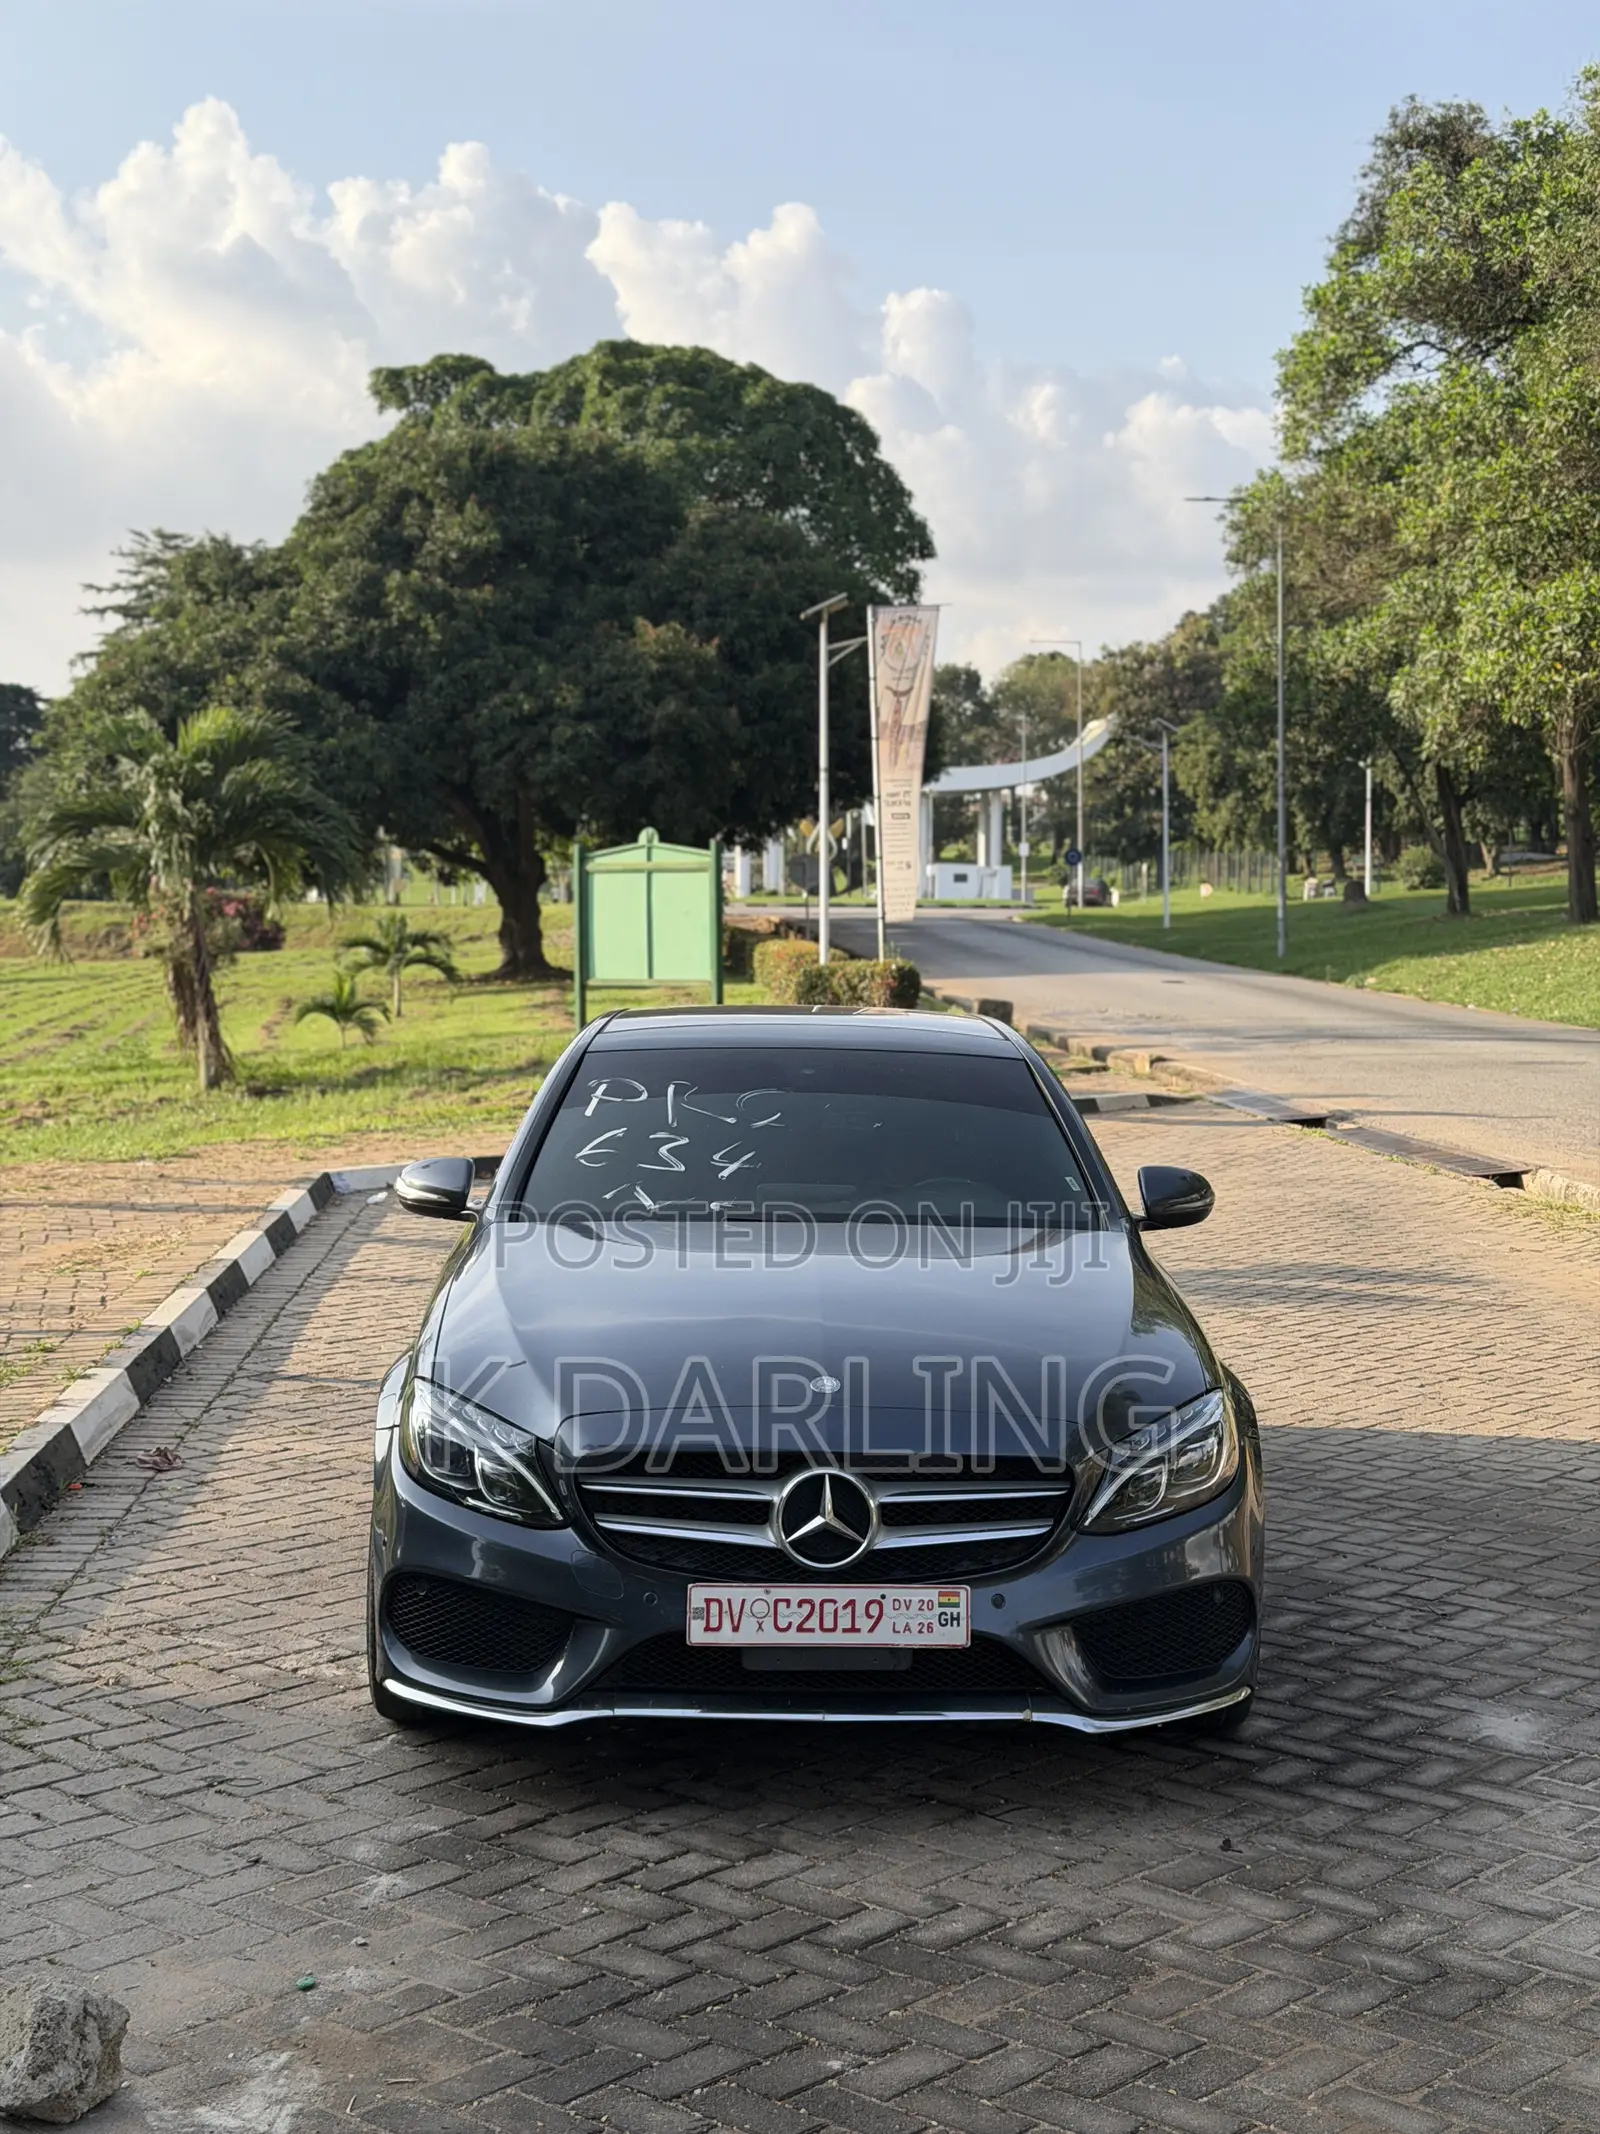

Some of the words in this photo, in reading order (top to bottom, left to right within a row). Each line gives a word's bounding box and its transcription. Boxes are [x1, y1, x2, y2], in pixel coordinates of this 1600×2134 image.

[892, 1598, 912, 1612] DV
[917, 1599, 935, 1612] 20
[703, 1598, 746, 1632] DV
[773, 1598, 884, 1633] C2019
[937, 1611, 961, 1627] GH
[892, 1621, 912, 1634] LA
[917, 1621, 935, 1634] 26
